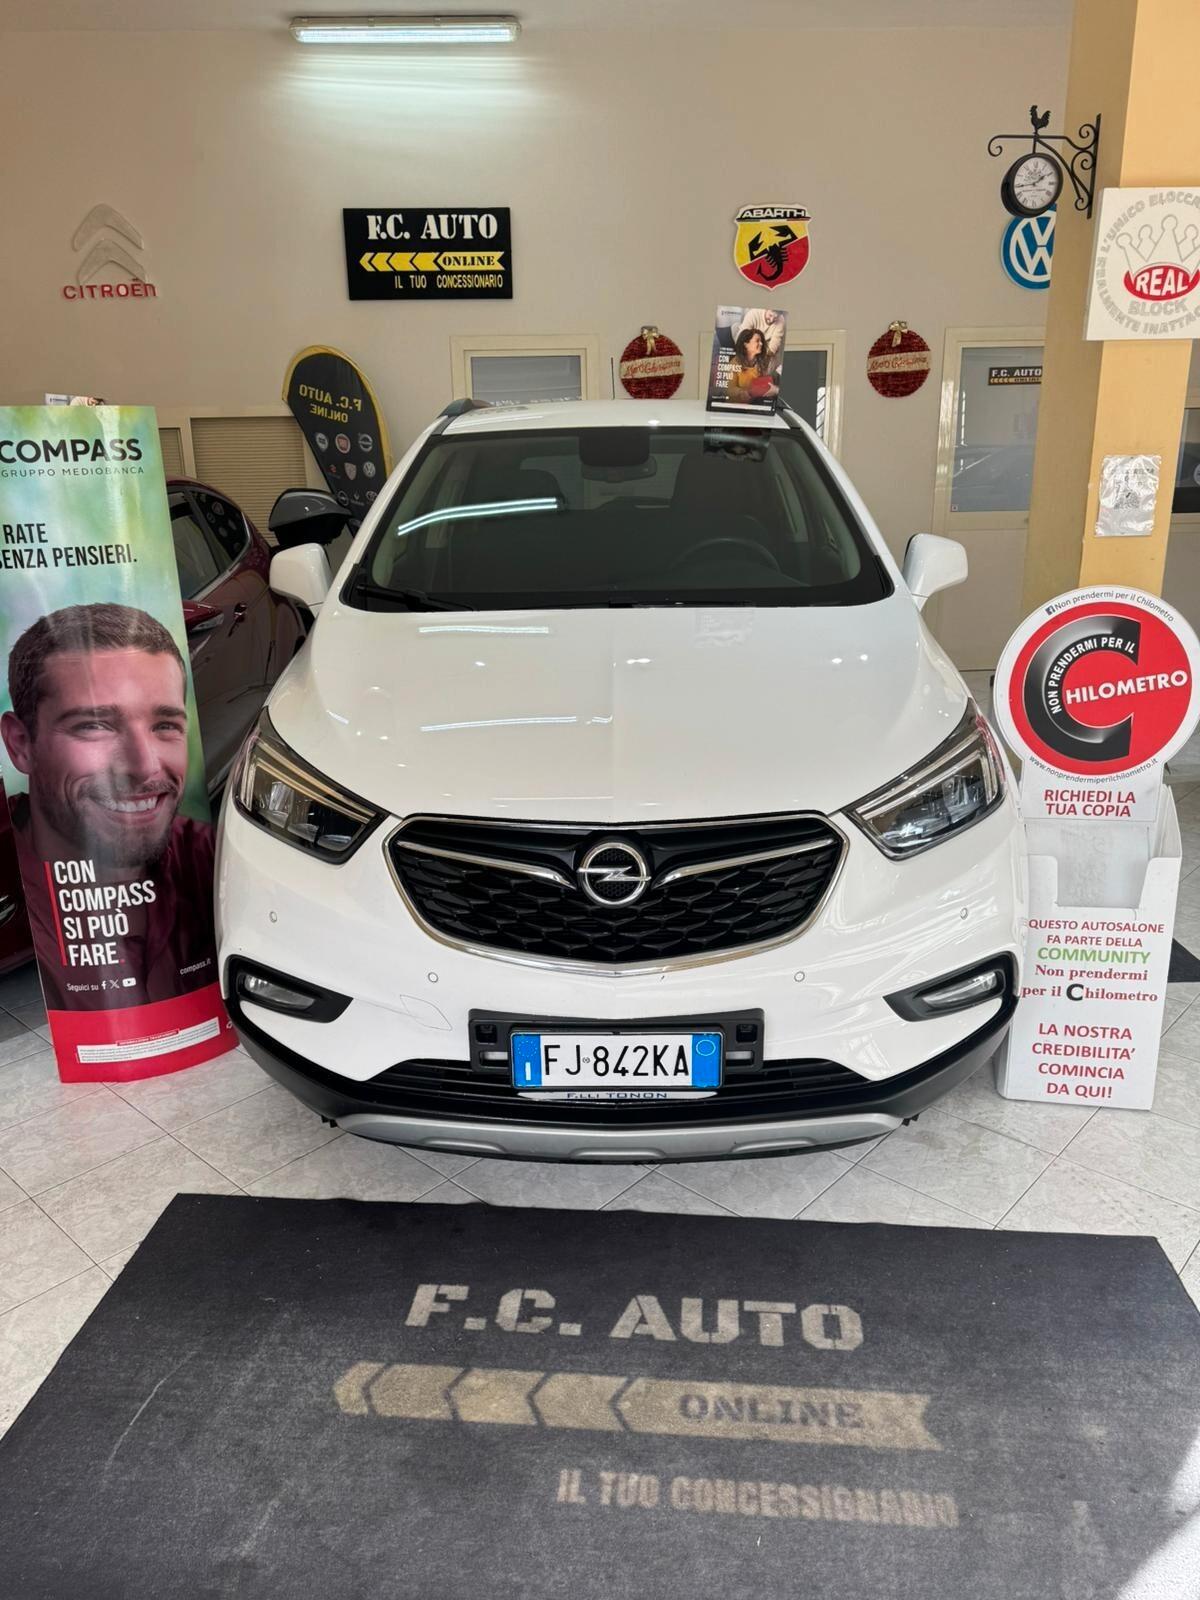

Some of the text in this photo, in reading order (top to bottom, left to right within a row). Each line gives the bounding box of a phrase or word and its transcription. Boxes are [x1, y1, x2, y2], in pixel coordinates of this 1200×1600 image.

[742, 208, 805, 218] ABARTH
[367, 213, 498, 240] F.C. AUTO
[442, 255, 496, 266] ONLINE
[394, 274, 503, 289] IL TUO CONCESSIONARIO
[1135, 268, 1189, 296] REAL
[1128, 300, 1188, 316] BLOCK
[1013, 368, 1042, 377] AUTO
[0, 438, 142, 464] COMPASS
[1, 466, 144, 478] GRUPPO MEDIOBANCA
[3, 523, 48, 544] RATE
[0, 543, 138, 569] ENZA PENSIERI.
[1055, 590, 1174, 622] Non prendermi per il Chilometro
[1048, 637, 1136, 714] NON PRENDERMI PER IL
[1065, 670, 1188, 705] HILOMETRO
[1044, 789, 1136, 803] RICHIEDI LA
[1046, 803, 1131, 817] TUA COPIA
[54, 860, 96, 884] CON
[59, 880, 156, 912] COMPASS
[63, 909, 129, 940] SI PUÒ
[1028, 919, 1165, 933] QUESTO AUTOSALONE
[1047, 935, 1143, 948] FA PARTE DELLA
[1037, 947, 1151, 964] COMMUNITY
[1035, 964, 1148, 981] Non prendermi
[67, 982, 90, 993] Seguici
[91, 983, 99, 991] su
[1021, 983, 1158, 1002] per il Chilometro
[1038, 1023, 1132, 1040] LA NOSTRA
[1038, 1062, 1125, 1080] COMINCIA
[1047, 1082, 1113, 1099] DA QUI!
[404, 1283, 865, 1351] F.C. AUTO
[678, 1393, 864, 1431] ONLINE
[557, 1469, 587, 1505] IL
[599, 1472, 661, 1508] TUO
